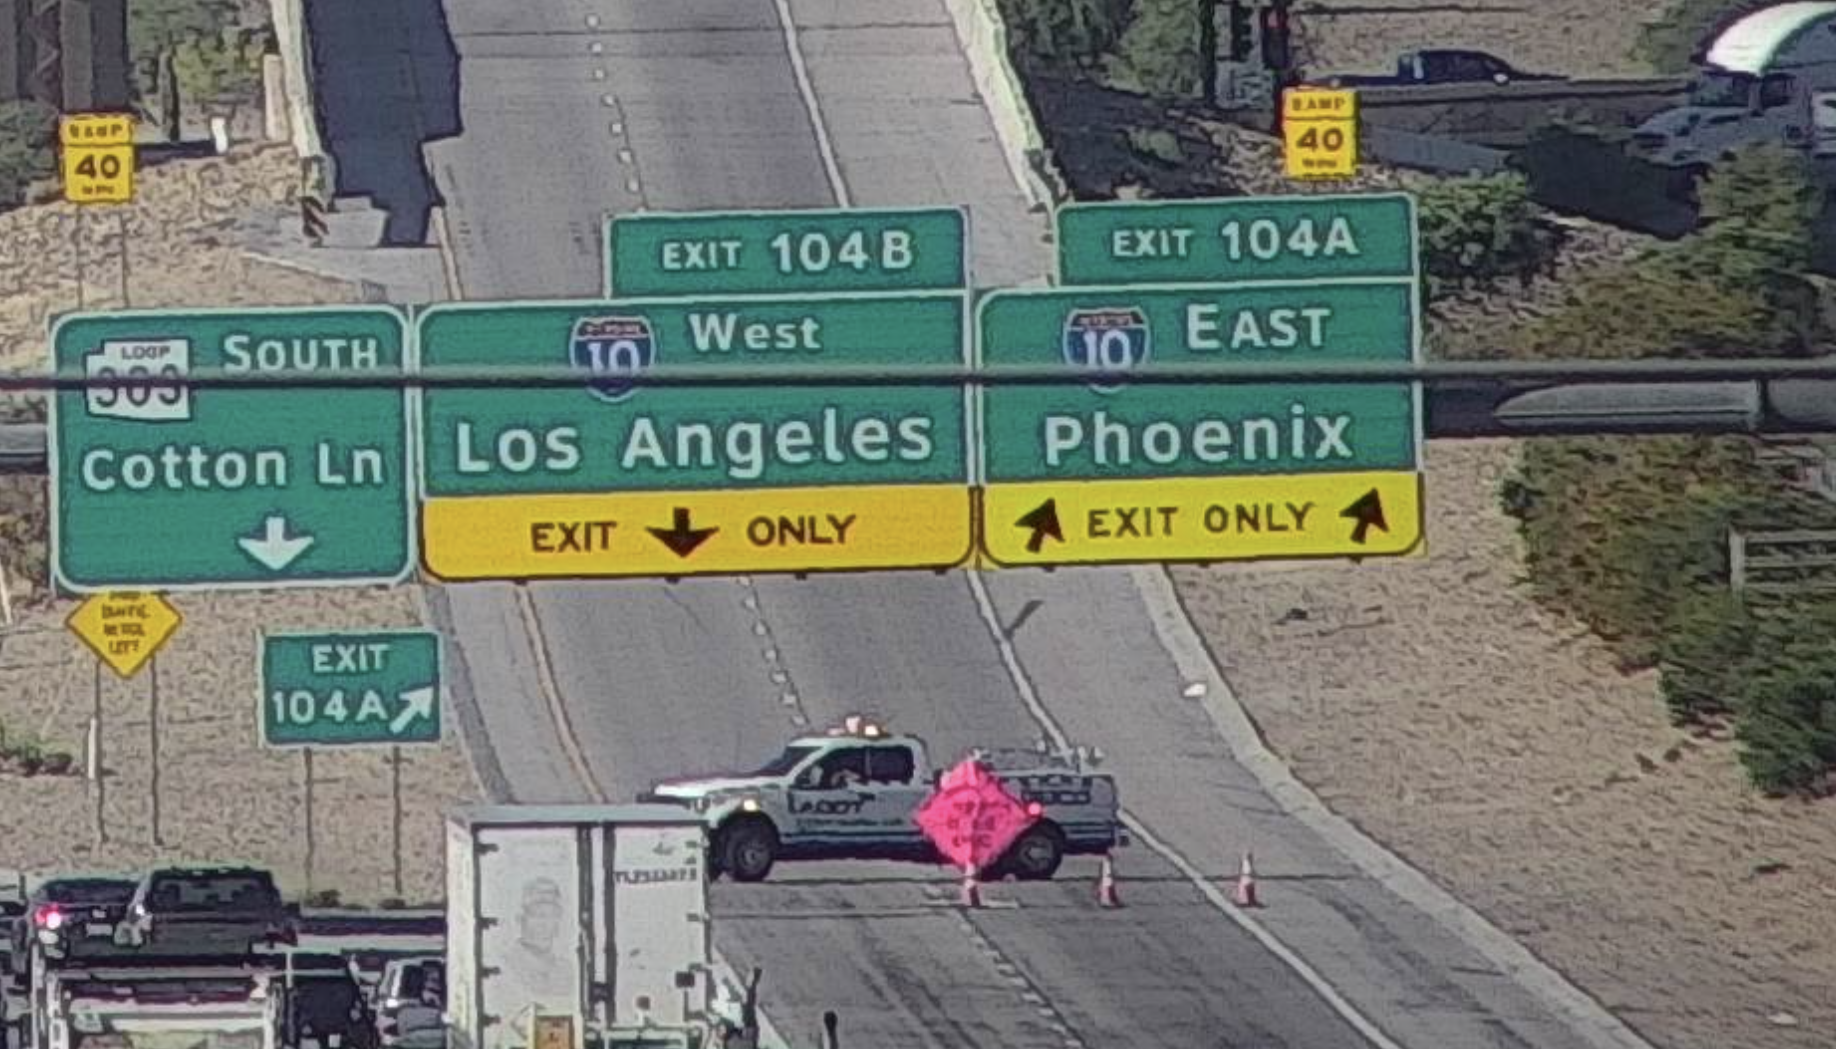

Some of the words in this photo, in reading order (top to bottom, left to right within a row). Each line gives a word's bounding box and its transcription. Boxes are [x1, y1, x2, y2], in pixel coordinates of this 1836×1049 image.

[1295, 127, 1344, 152] 40
[74, 153, 121, 180] 40
[662, 239, 743, 271] EXIT
[771, 229, 913, 274] 104B
[1112, 227, 1193, 258] EXIT
[1221, 216, 1361, 261] 104A
[689, 312, 821, 352] West
[1185, 303, 1332, 351] EAST
[121, 345, 171, 360] LOOP
[222, 333, 379, 374] SOUTH
[586, 339, 641, 378] 10
[1083, 329, 1132, 369] 10
[95, 363, 182, 408] 303
[456, 421, 580, 473] Los
[621, 407, 933, 480] Angeles
[1044, 403, 1354, 467] Phoenix
[81, 445, 288, 491] Cotton
[317, 441, 385, 485] Ln
[530, 520, 617, 554] EXIT
[746, 513, 857, 548] ONLY
[1086, 505, 1180, 539] EXIT
[1202, 500, 1317, 534] ONLY
[311, 642, 391, 675] EXIT
[271, 688, 390, 725] 104A
